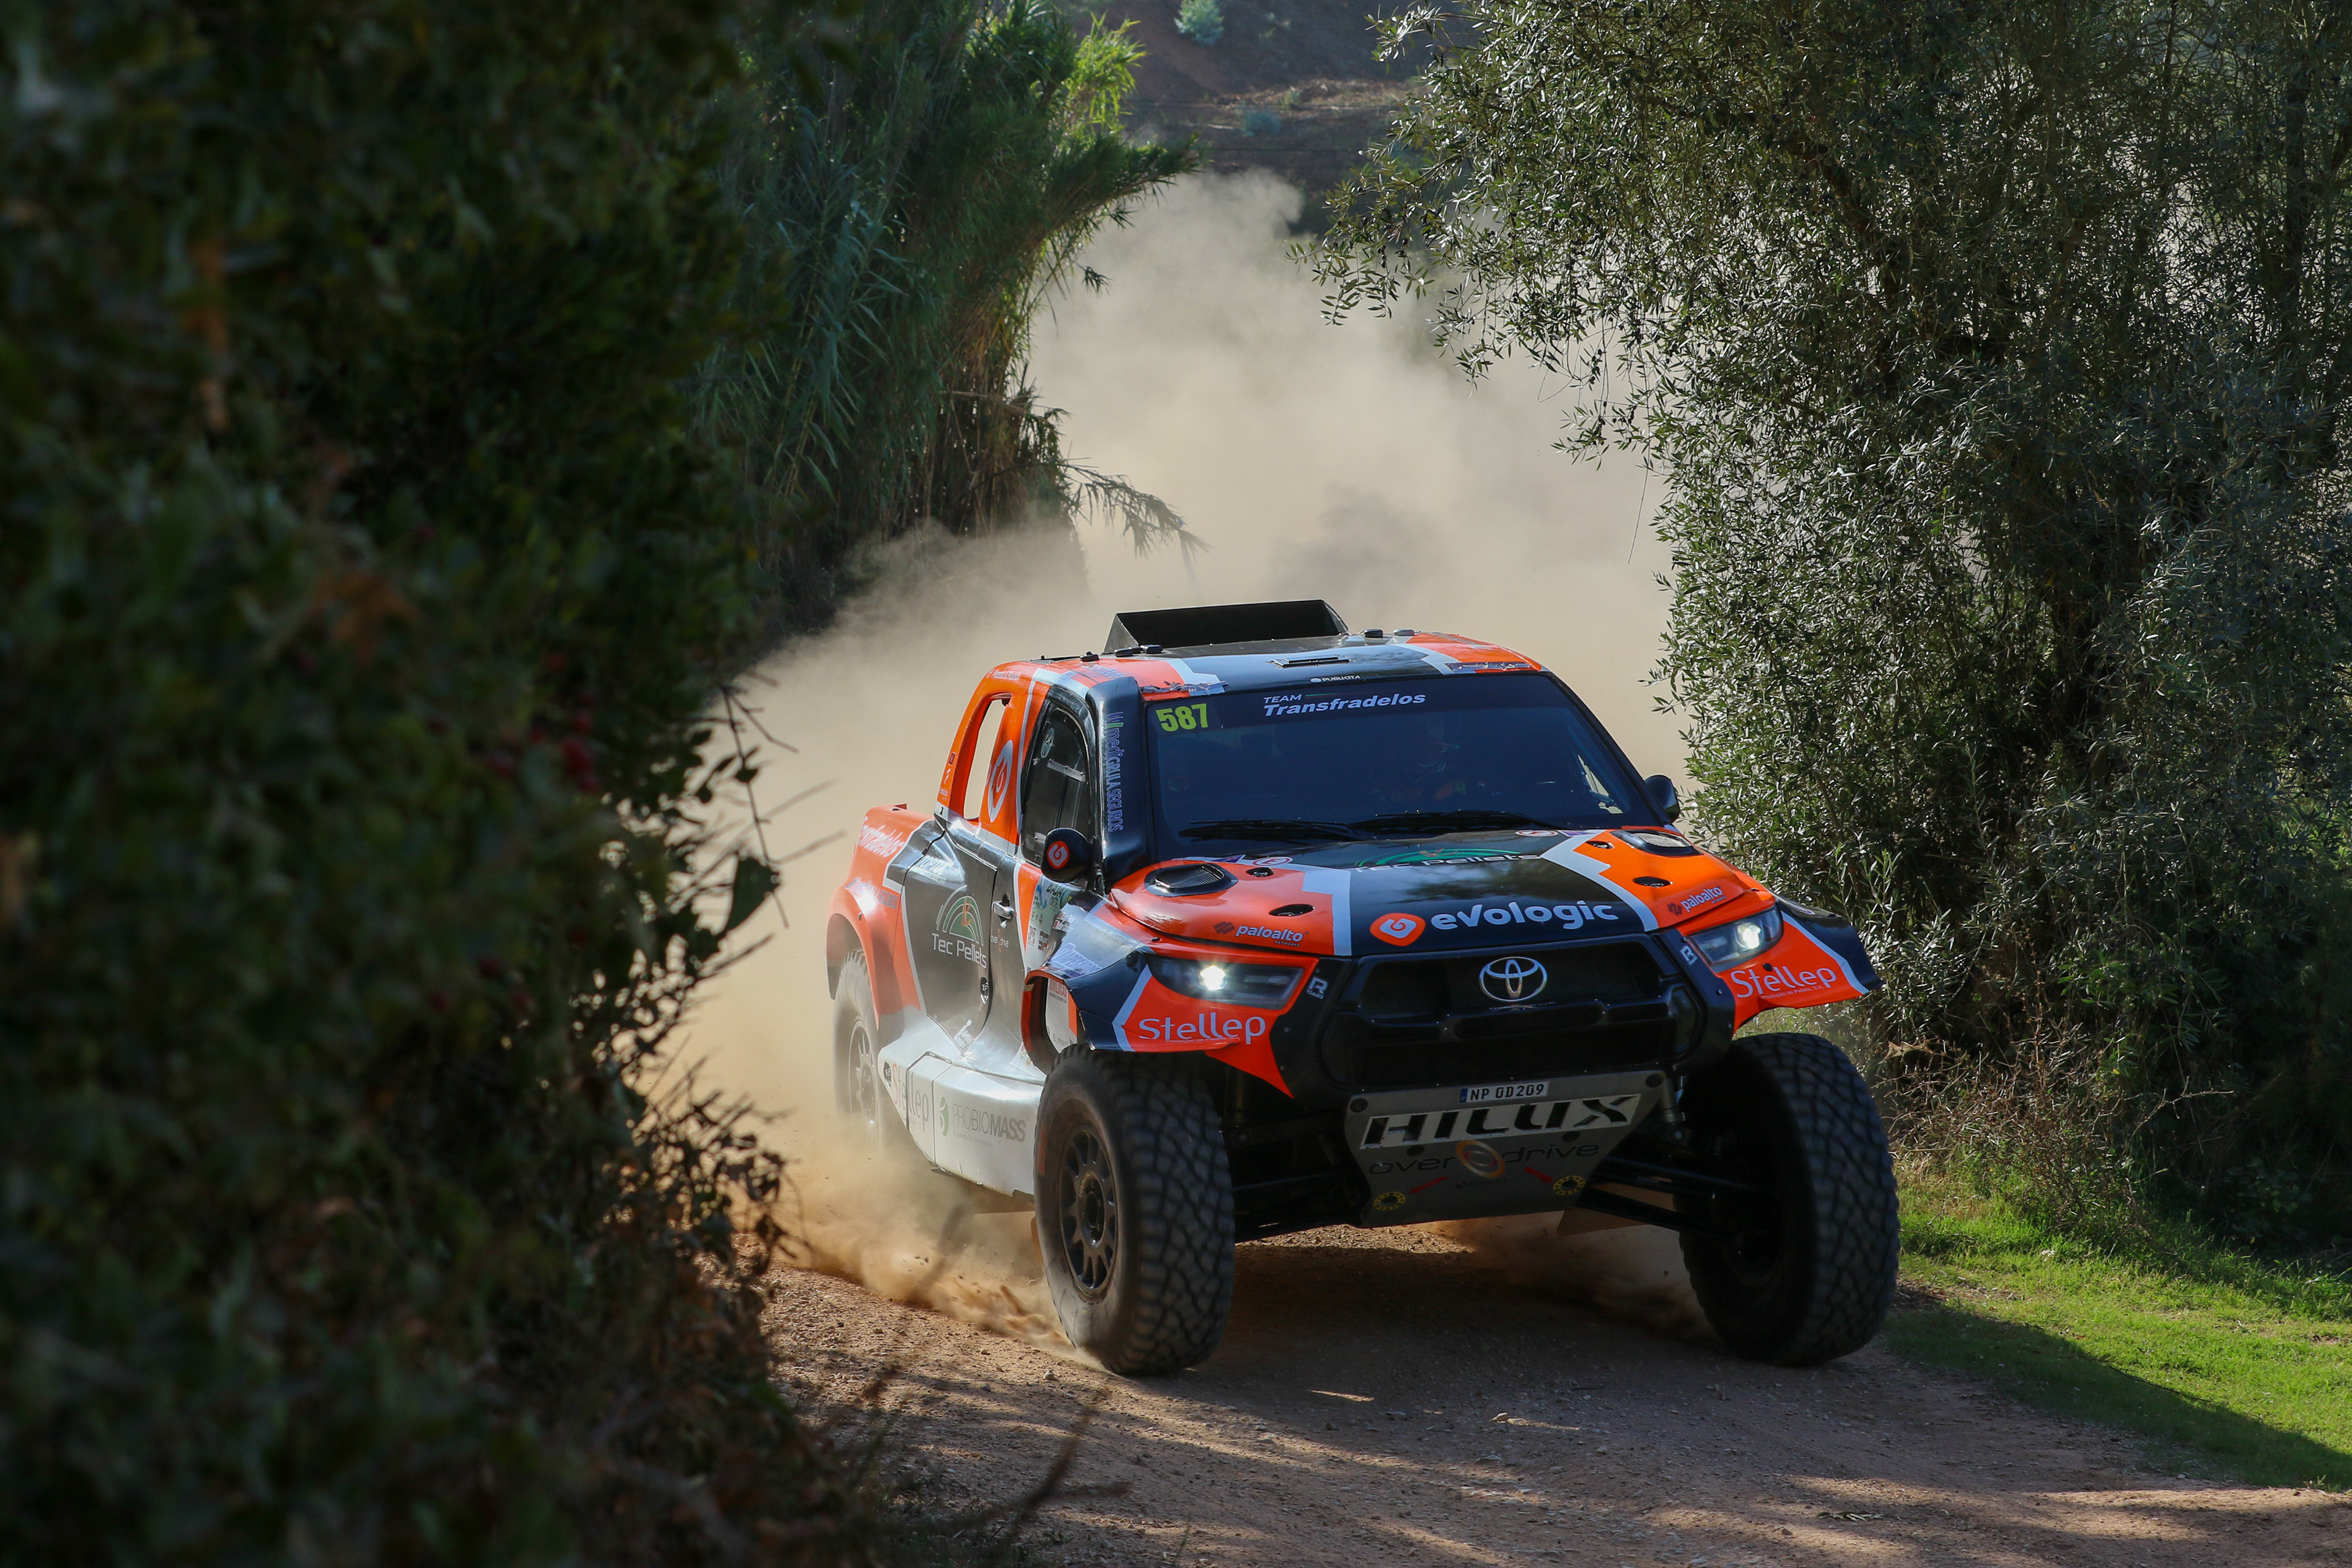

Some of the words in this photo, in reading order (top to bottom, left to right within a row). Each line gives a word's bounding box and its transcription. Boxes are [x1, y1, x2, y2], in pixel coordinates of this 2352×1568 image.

[1263, 693, 1302, 704] TEAM
[1263, 693, 1427, 717] Transfradelos
[1155, 703, 1208, 732] 587
[1107, 788, 1123, 832] SEGUROS
[1349, 862, 1413, 873] Tec
[1421, 854, 1542, 865] Pellets
[1680, 886, 1723, 913] paloalto
[1235, 925, 1303, 942] paloalto
[932, 932, 953, 955] Tec
[956, 940, 987, 968] Pellets
[1730, 966, 1837, 998] Stellep
[1139, 1012, 1266, 1045] Stellep
[892, 1063, 930, 1133] Stellep
[1471, 1088, 1490, 1101] NP
[952, 1103, 1027, 1143] PROBIOMASS
[1363, 1095, 1639, 1145] HILUX
